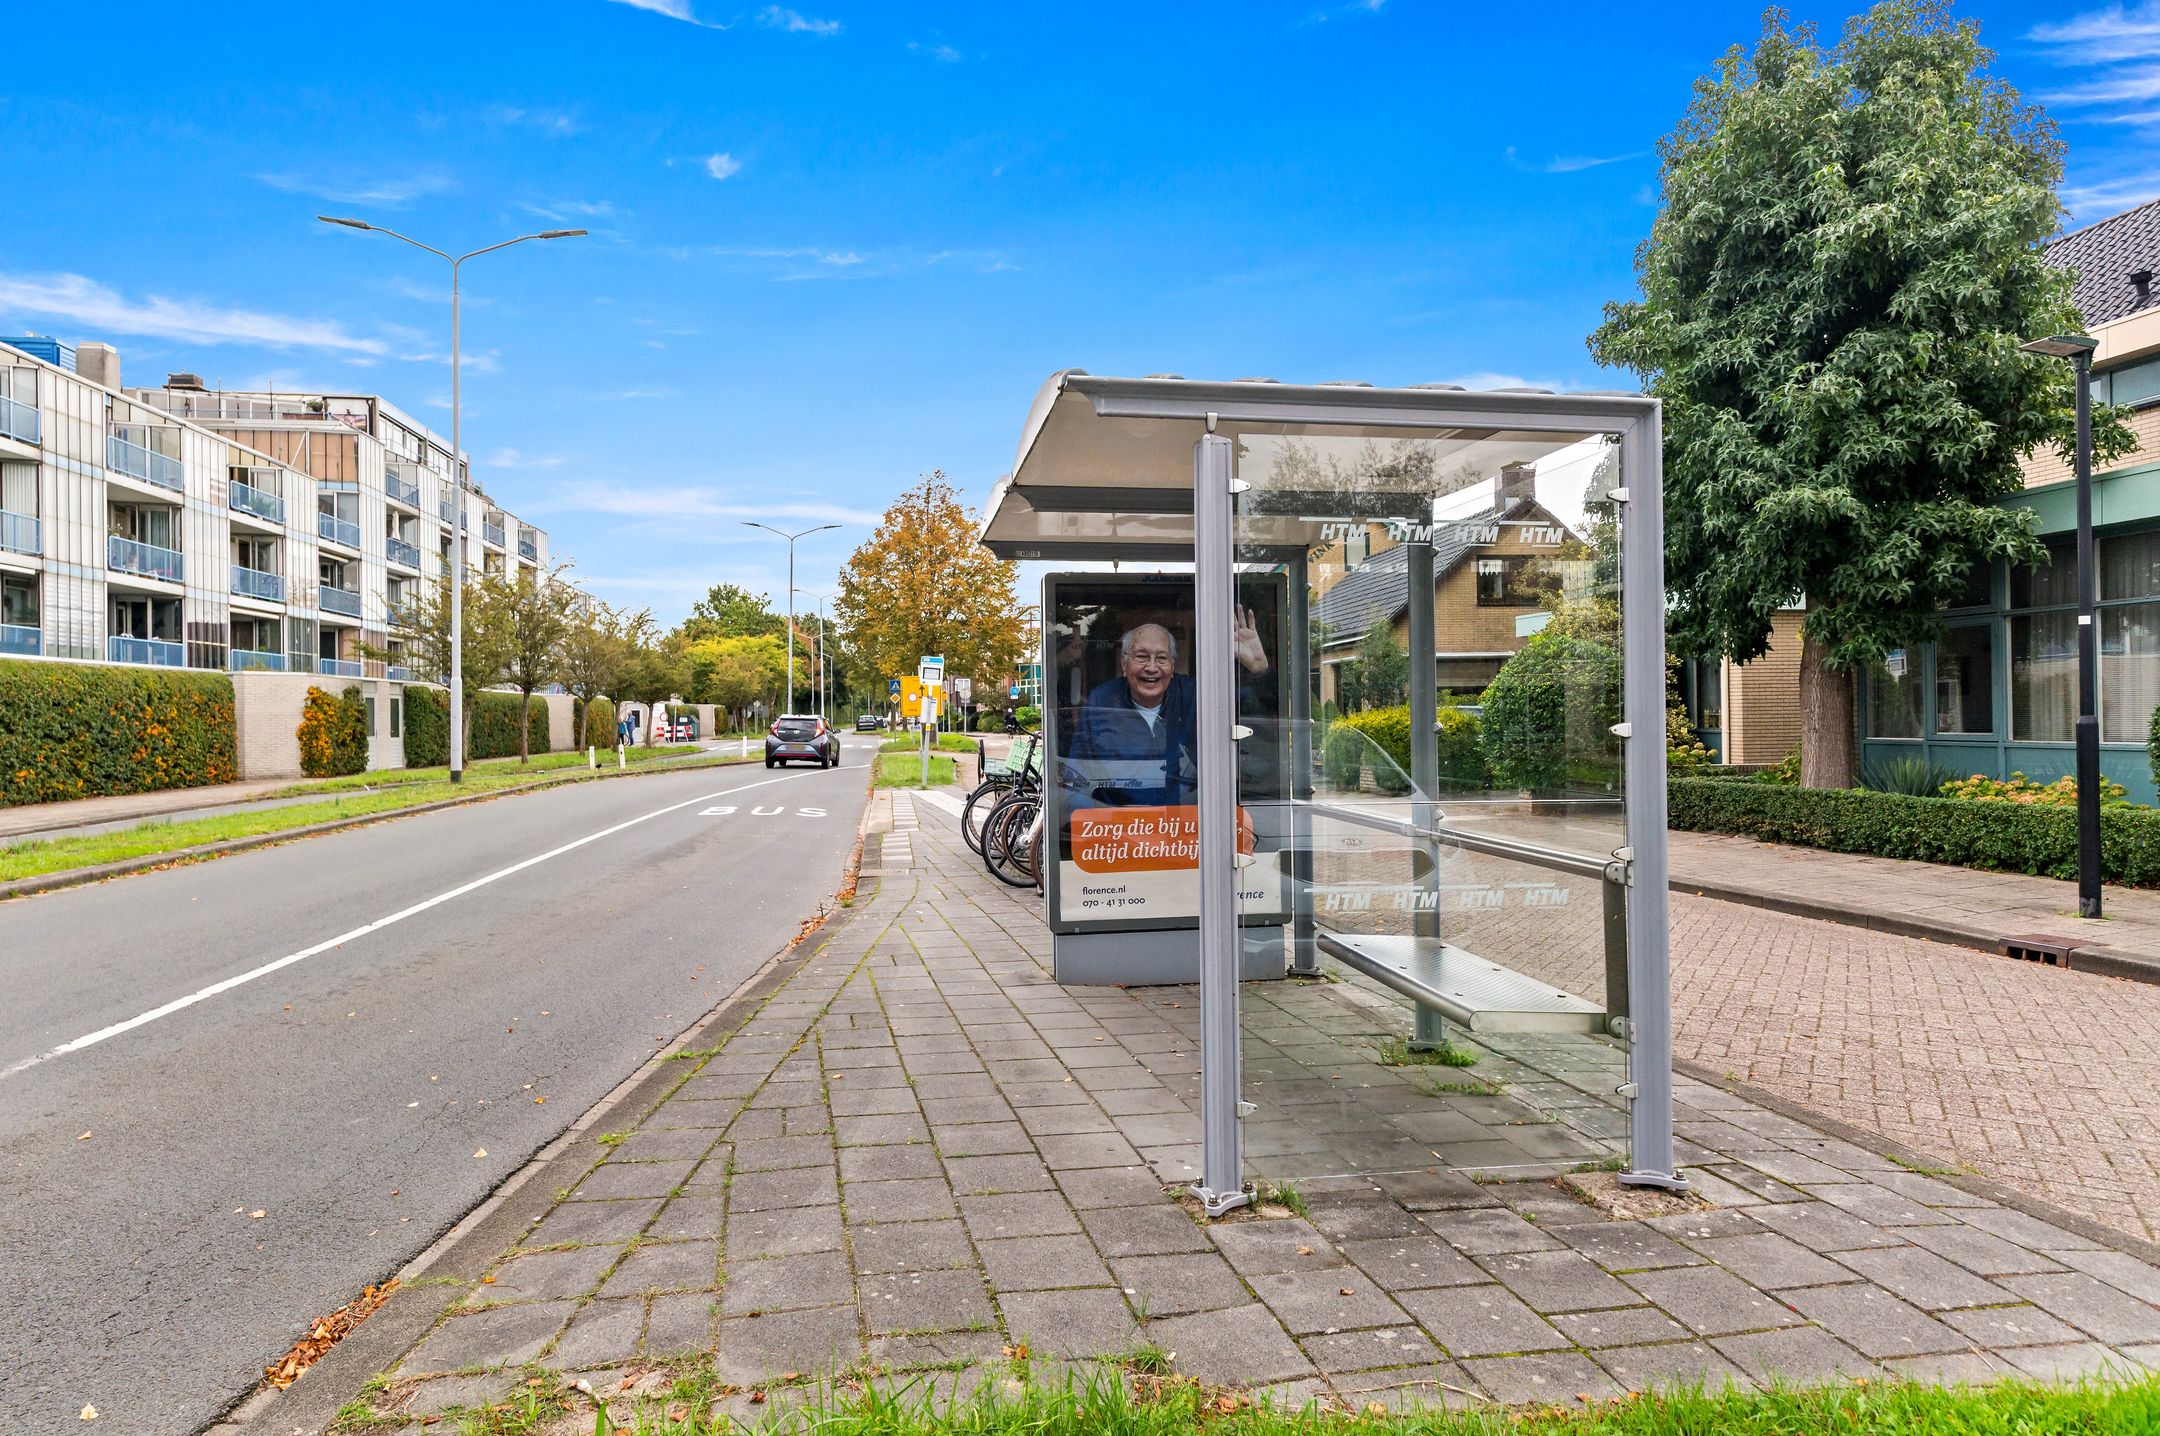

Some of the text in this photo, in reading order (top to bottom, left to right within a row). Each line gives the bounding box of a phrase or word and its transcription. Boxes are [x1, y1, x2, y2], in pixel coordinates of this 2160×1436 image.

[1320, 524, 1564, 543] HTM HTM HTM HTM
[697, 806, 828, 817] BUS
[1081, 817, 1196, 840] Zorg die bij u
[1081, 840, 1199, 864] altijd dichtbij
[1082, 885, 1126, 895] florence.nl
[1325, 889, 1569, 910] HTM HTM HTM HTM
[1082, 899, 1099, 908] 070
[1106, 899, 1116, 908] 41
[1118, 898, 1126, 907] 31
[1128, 896, 1146, 905] 000
